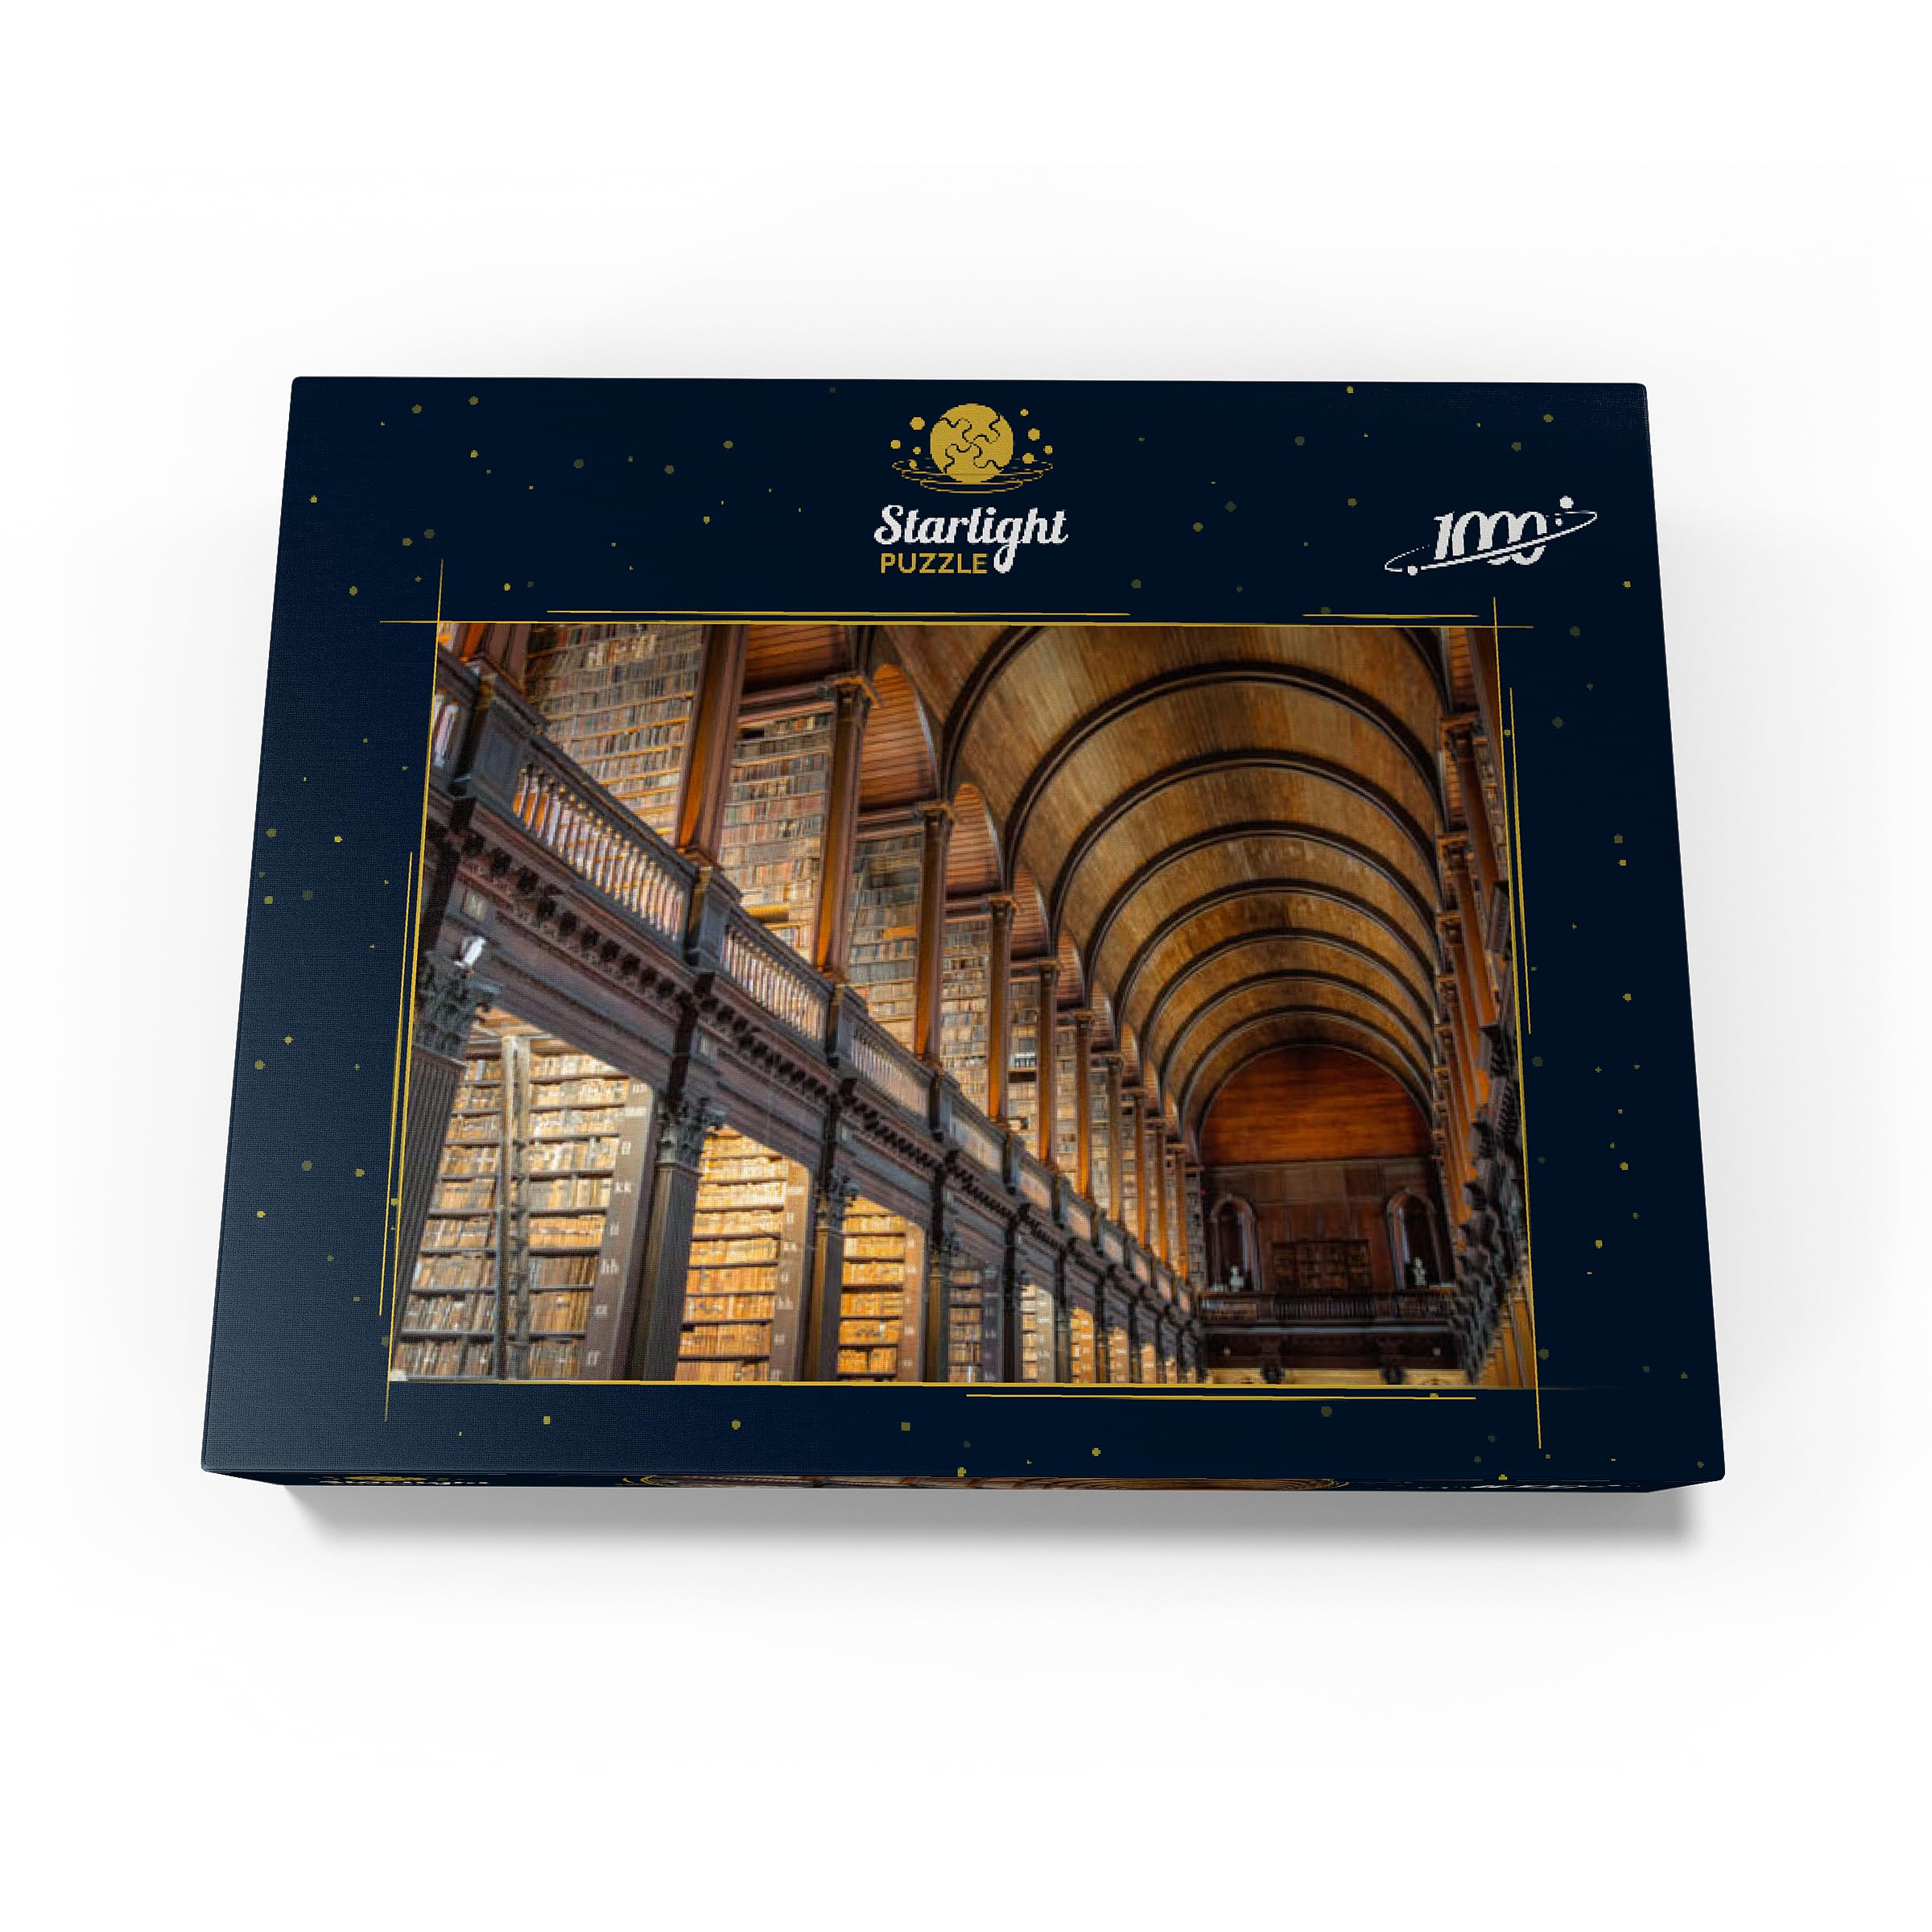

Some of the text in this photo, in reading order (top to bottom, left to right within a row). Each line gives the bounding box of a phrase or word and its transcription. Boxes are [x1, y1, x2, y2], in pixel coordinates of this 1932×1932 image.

[873, 504, 1069, 574] Starlight
[881, 552, 989, 574] PUZZLE
[1434, 510, 1547, 565] 1000
